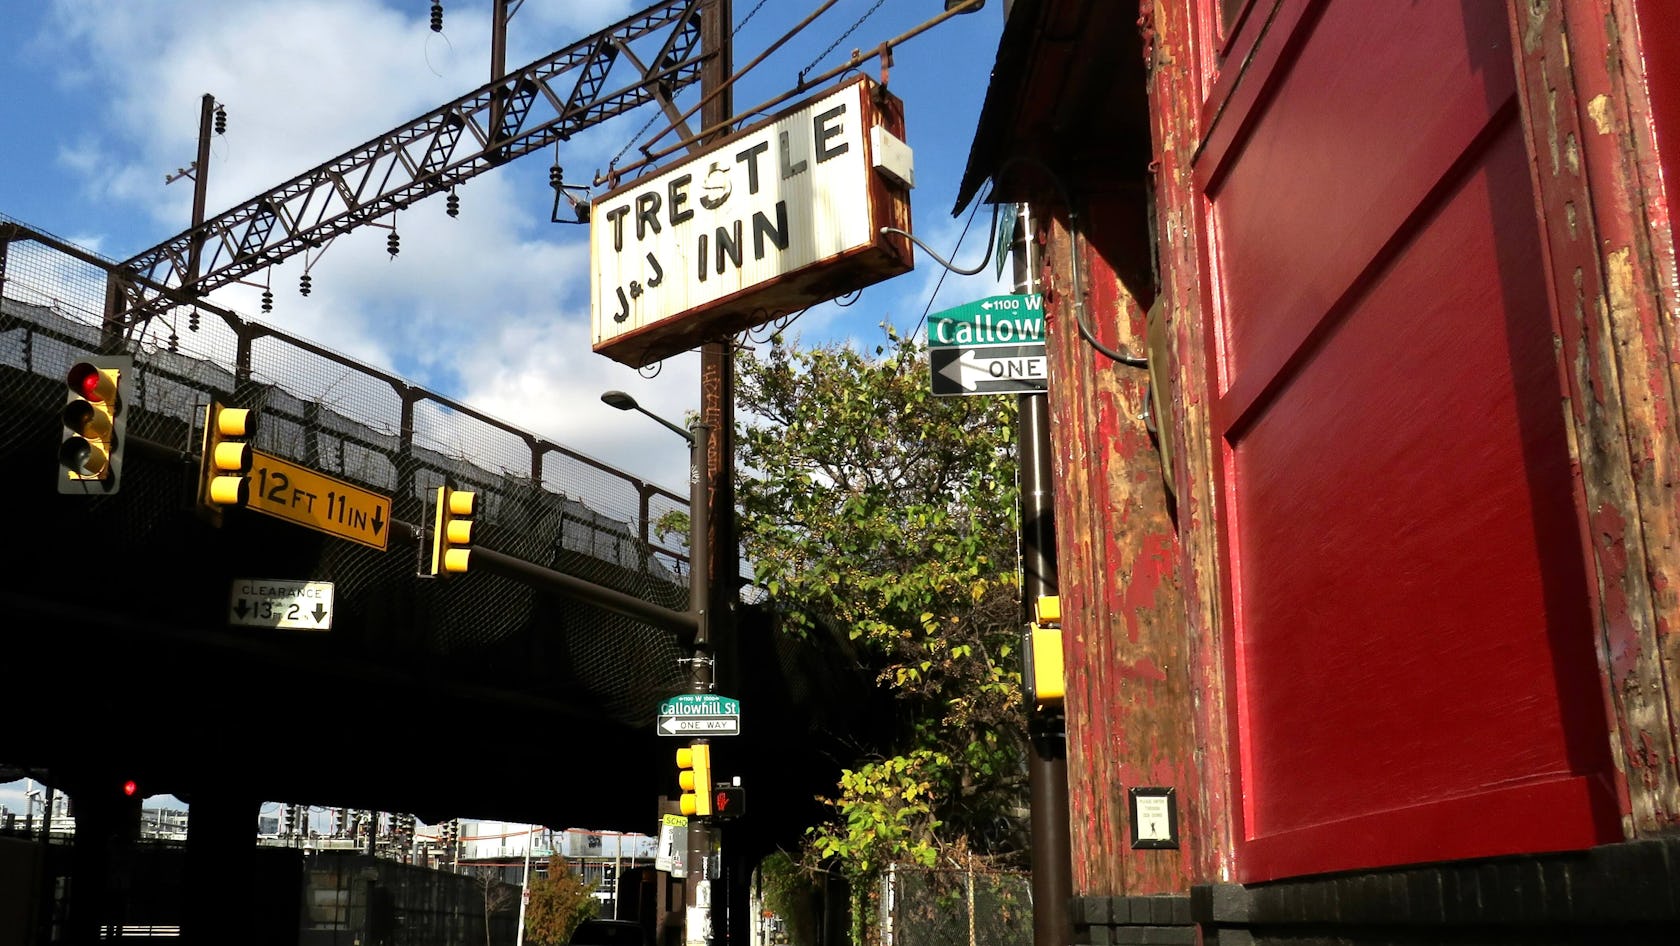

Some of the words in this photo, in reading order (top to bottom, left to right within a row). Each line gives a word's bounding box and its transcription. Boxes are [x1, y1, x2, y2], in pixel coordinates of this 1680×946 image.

[606, 103, 849, 252] TRESTLE
[698, 200, 789, 282] INN
[994, 299, 1019, 310] 1100
[1025, 296, 1041, 311] W
[989, 358, 1041, 378] ONE
[241, 585, 322, 599] CLEARANCE
[661, 702, 720, 715] Callowhill
[725, 702, 737, 714] St
[680, 721, 700, 729] ONE
[706, 721, 727, 729] WAY
